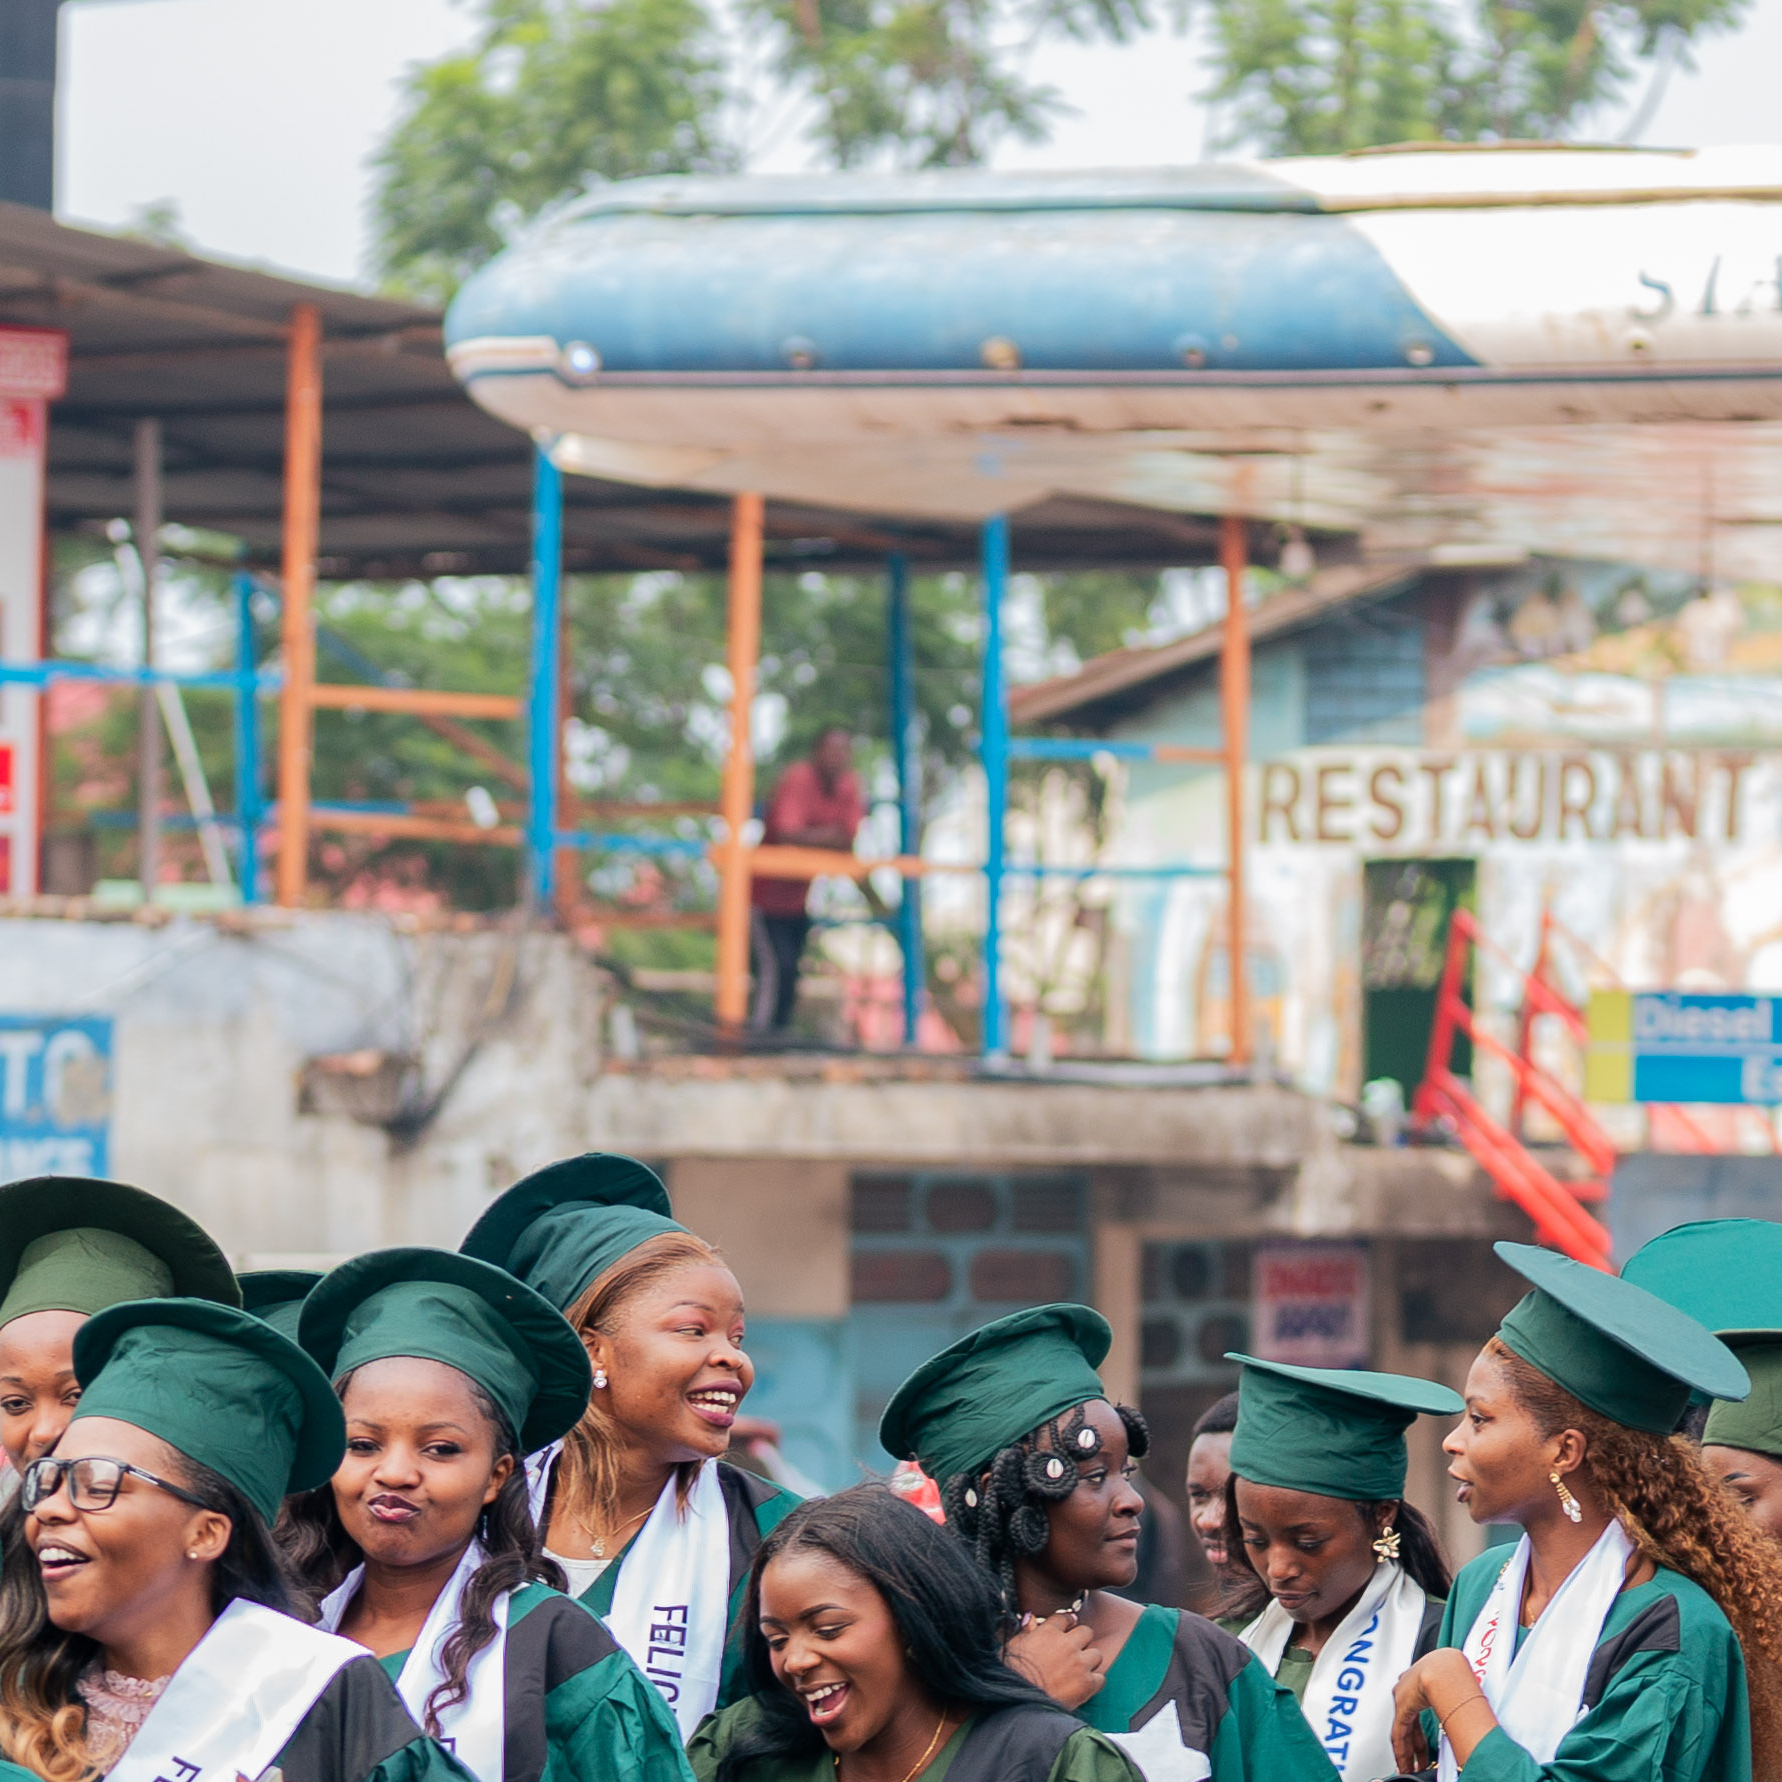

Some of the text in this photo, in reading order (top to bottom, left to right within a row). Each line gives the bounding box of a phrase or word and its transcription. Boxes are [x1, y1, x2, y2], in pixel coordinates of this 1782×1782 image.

[1259, 757, 1747, 842] RESTAURANT
[1635, 996, 1773, 1041] Diesel
[646, 1605, 687, 1715] FELIC
[1324, 1600, 1388, 1772] NGRAT
